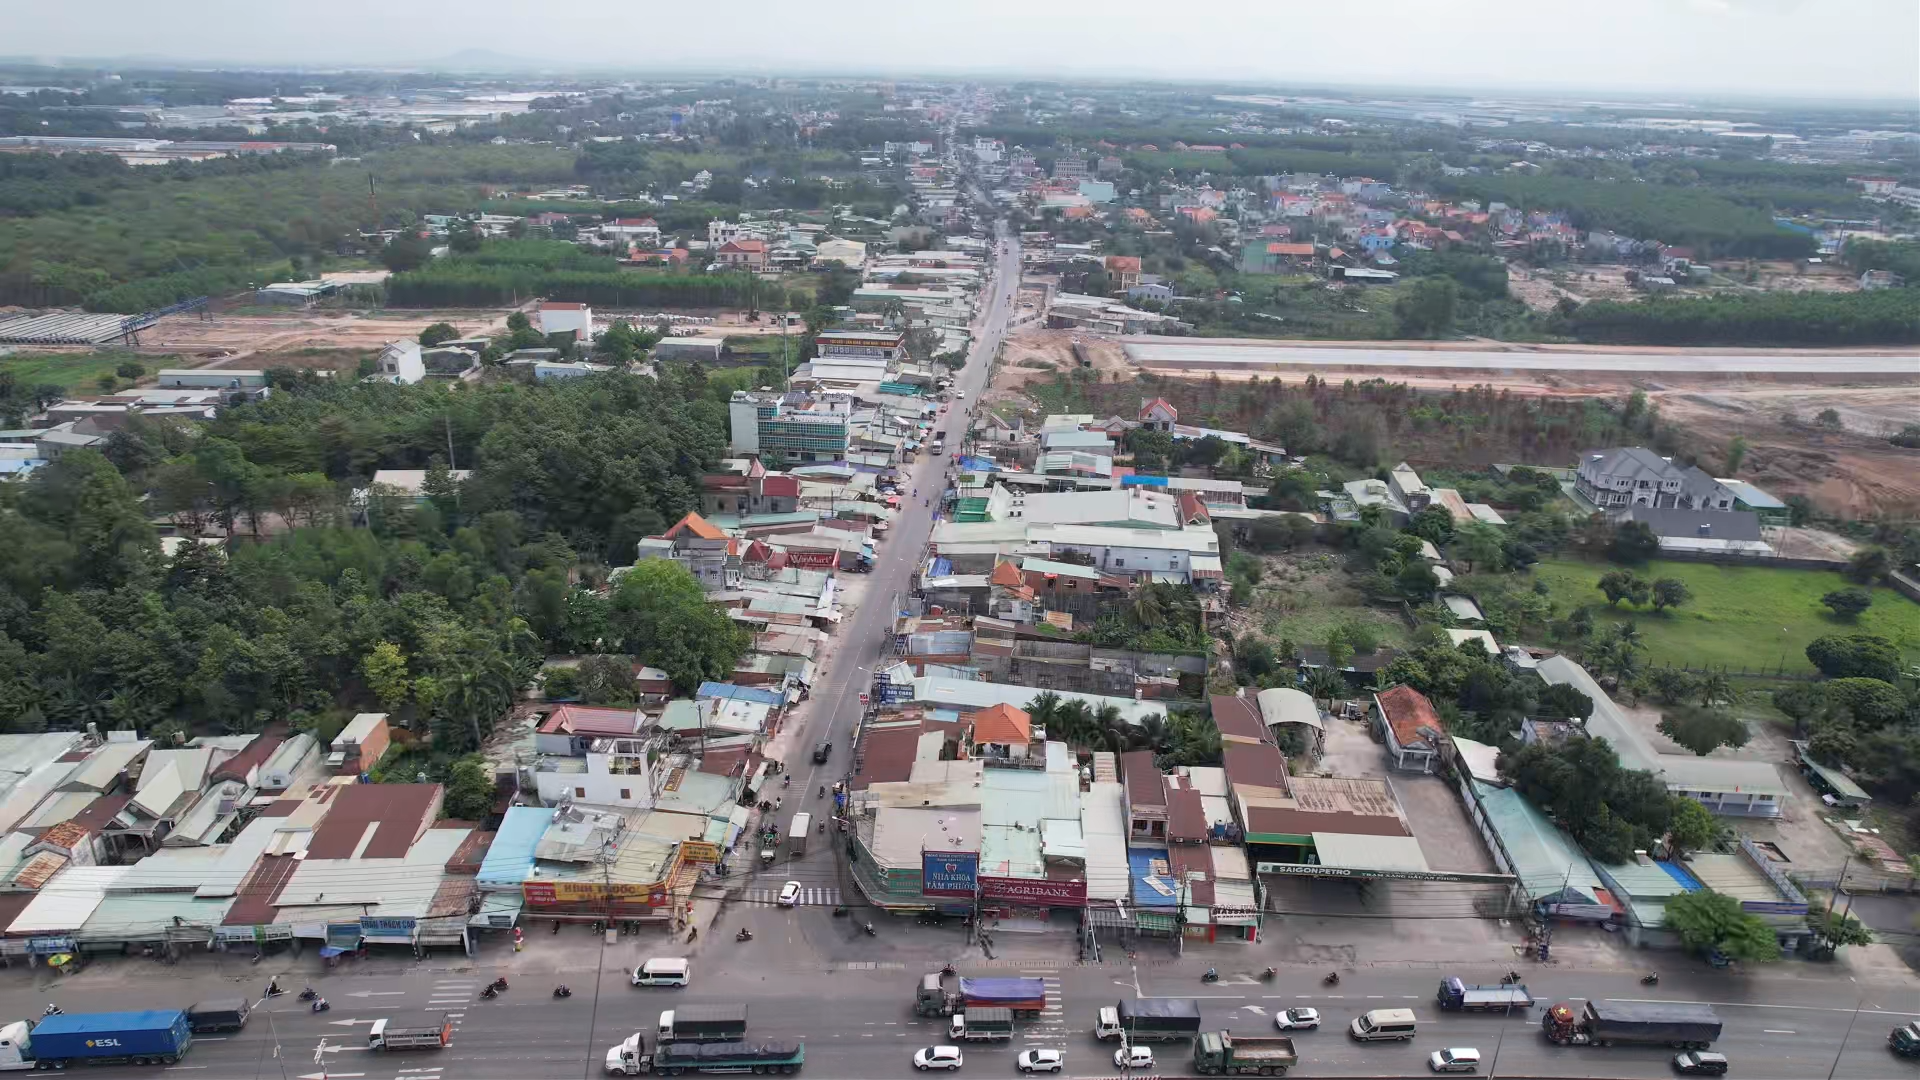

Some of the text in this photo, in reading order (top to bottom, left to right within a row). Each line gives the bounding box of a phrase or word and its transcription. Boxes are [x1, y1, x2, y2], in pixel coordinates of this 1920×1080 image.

[1279, 866, 1351, 876] SAIGONPETRO
[950, 873, 971, 882] KHOA
[927, 880, 945, 889] TÂM
[1007, 886, 1071, 897] AGRIBANK
[95, 1038, 122, 1047] ESL
